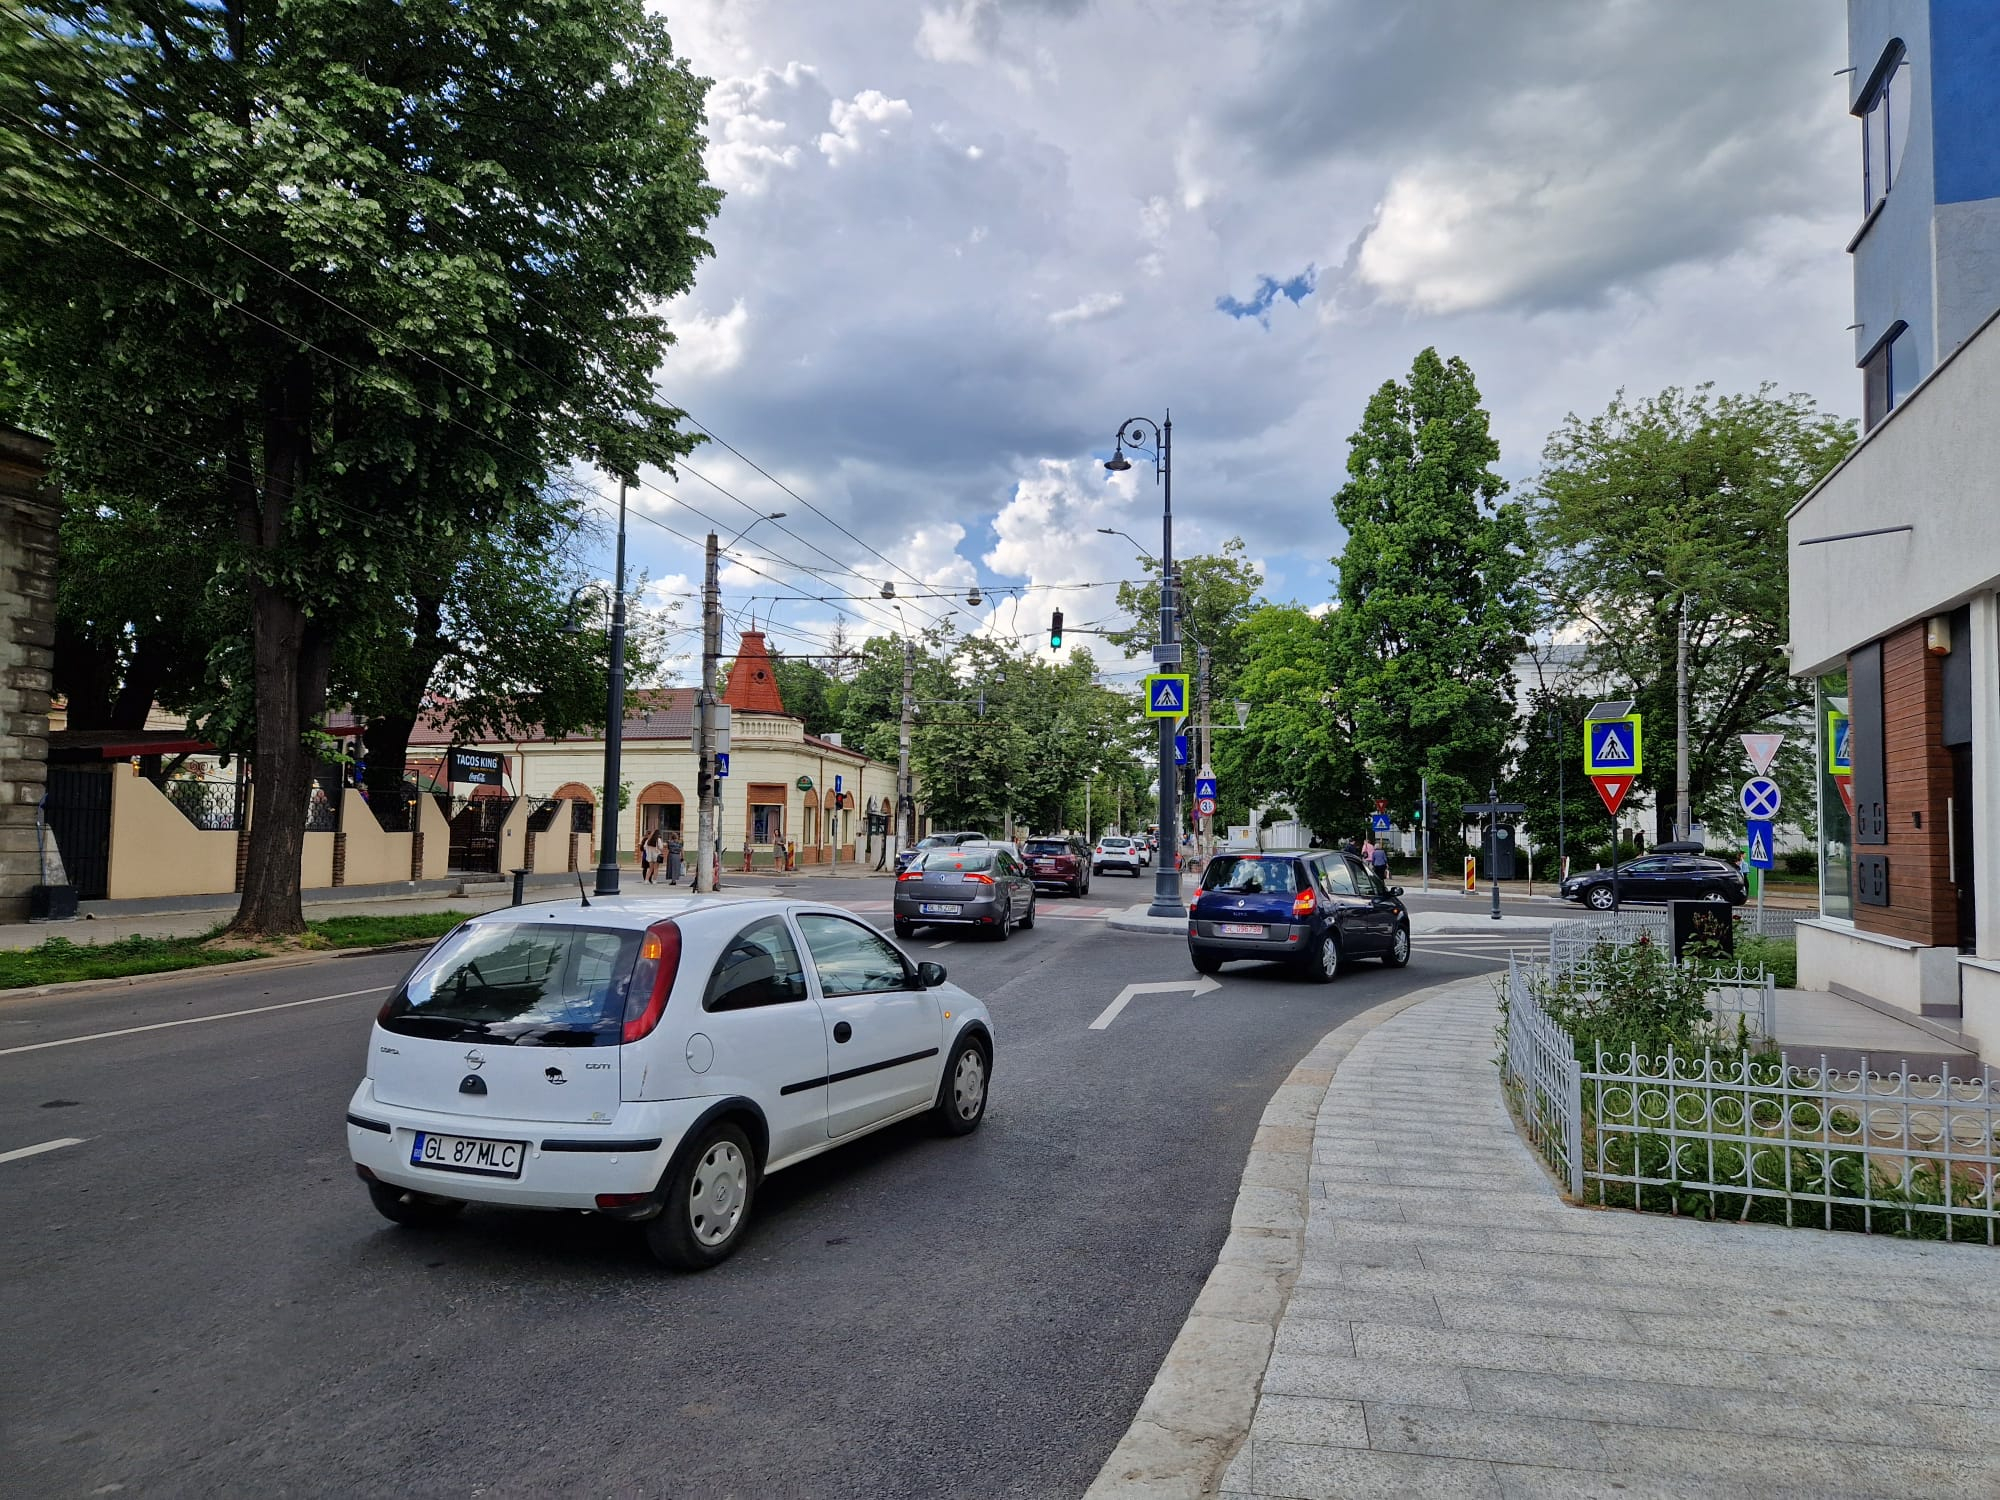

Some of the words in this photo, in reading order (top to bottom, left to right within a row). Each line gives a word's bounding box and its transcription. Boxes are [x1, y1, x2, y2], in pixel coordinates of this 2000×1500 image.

[456, 754, 480, 767] TACOS
[480, 757, 498, 769] KING
[425, 1138, 445, 1161] GL
[453, 1141, 476, 1163] 87
[477, 1143, 516, 1167] MLC
